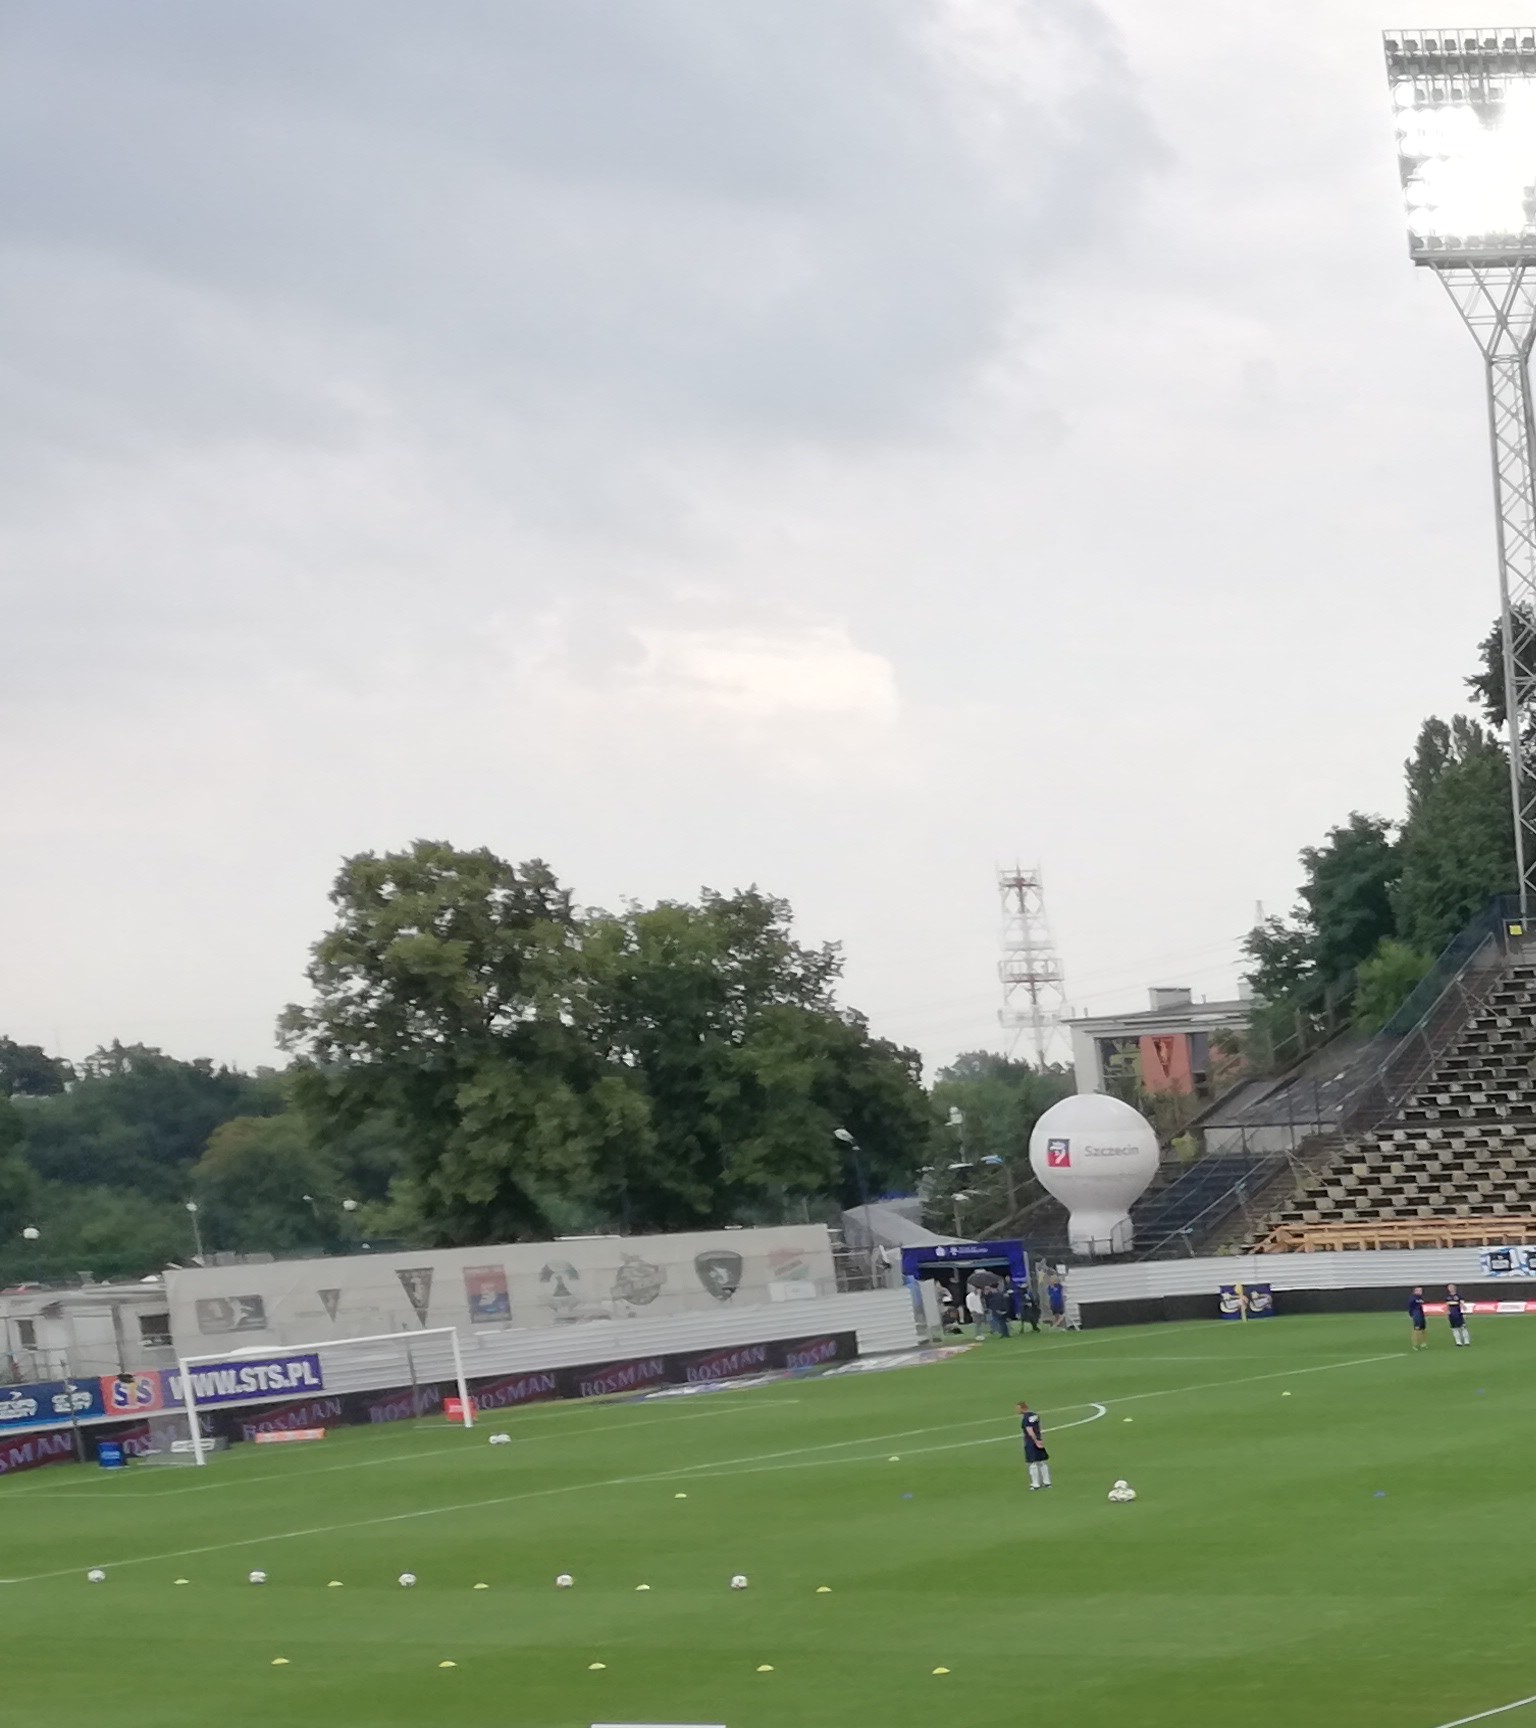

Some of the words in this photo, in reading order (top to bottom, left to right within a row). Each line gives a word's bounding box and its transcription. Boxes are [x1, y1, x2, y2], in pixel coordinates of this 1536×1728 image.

[1084, 1144, 1139, 1157] Szczecin
[580, 1358, 664, 1398] BOSMAN
[686, 1345, 766, 1382] BOSMAN
